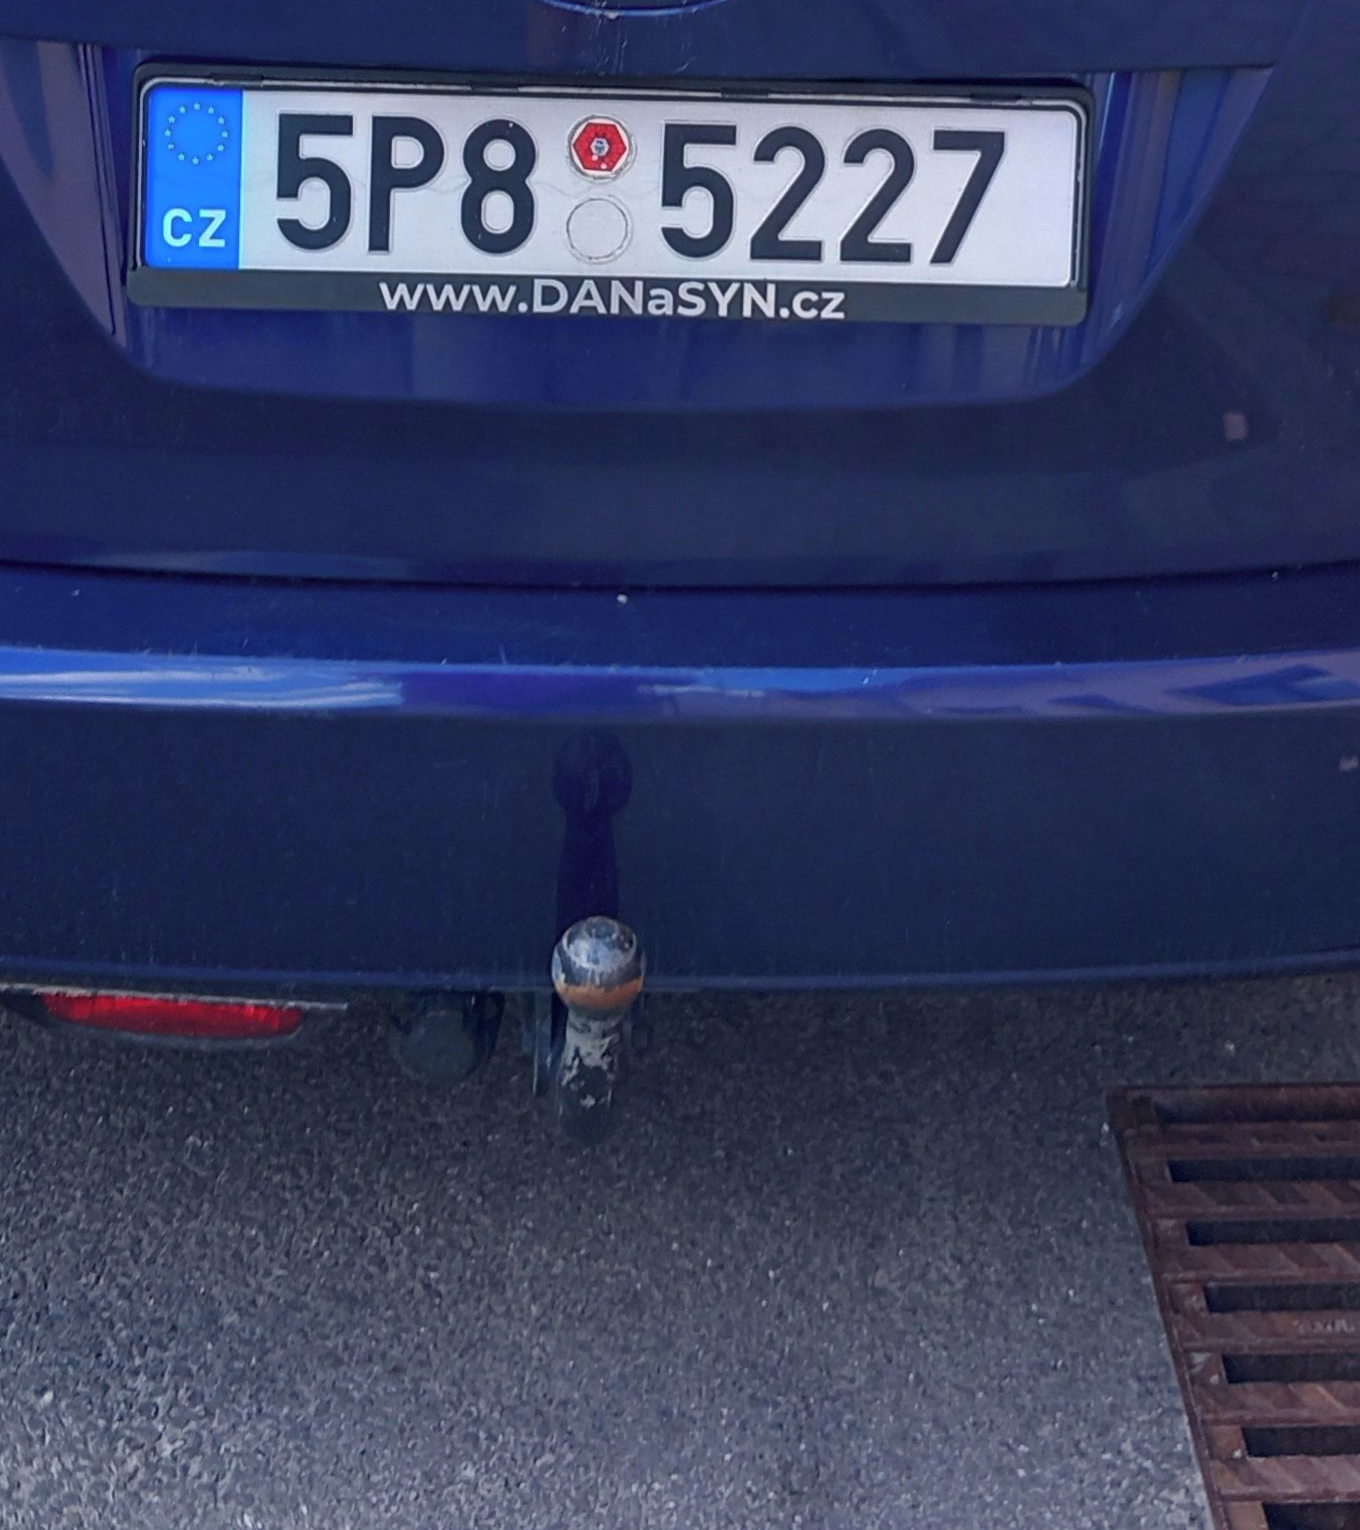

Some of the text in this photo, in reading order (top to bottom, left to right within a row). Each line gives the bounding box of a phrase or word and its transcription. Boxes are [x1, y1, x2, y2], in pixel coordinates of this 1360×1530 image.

[276, 112, 1006, 266] 5P8 5227
[162, 207, 227, 248] CZ
[379, 278, 846, 320] www.DANaSYN.cz
